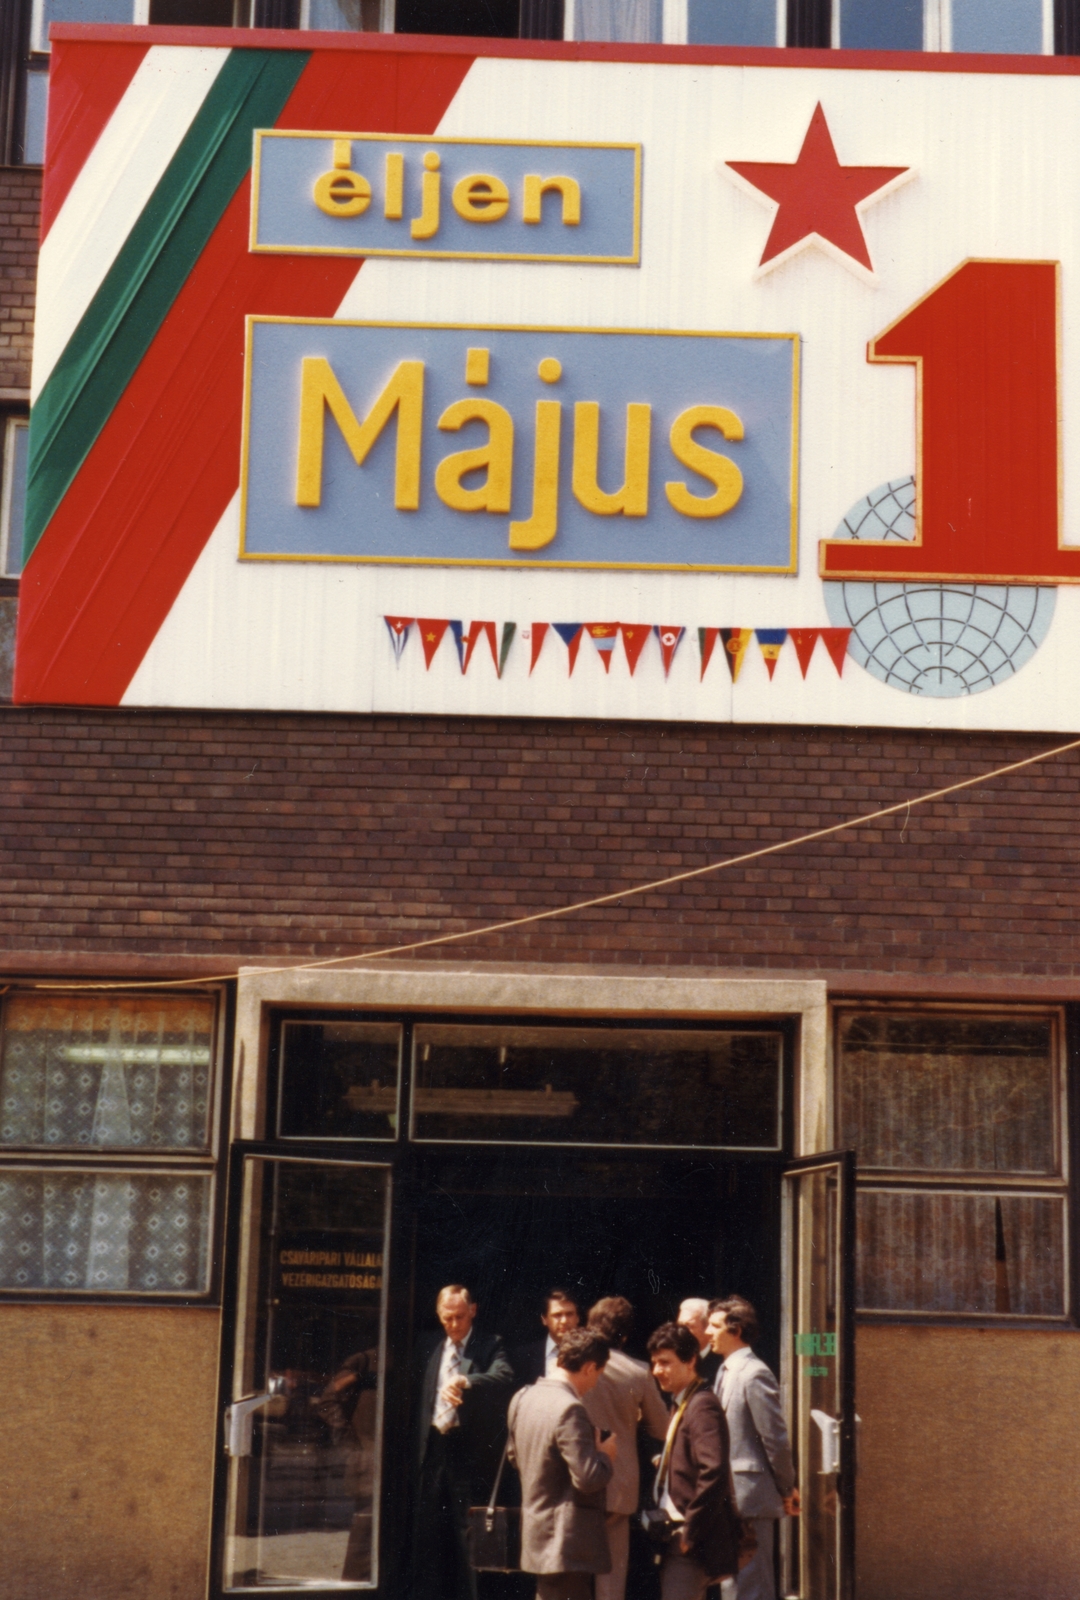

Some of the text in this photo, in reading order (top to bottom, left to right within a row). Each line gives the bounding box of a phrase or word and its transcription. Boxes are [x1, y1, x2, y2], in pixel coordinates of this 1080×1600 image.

[313, 139, 581, 240] éljen
[295, 257, 1080, 583] Május 1
[344, 1250, 383, 1268] VÁLLALA
